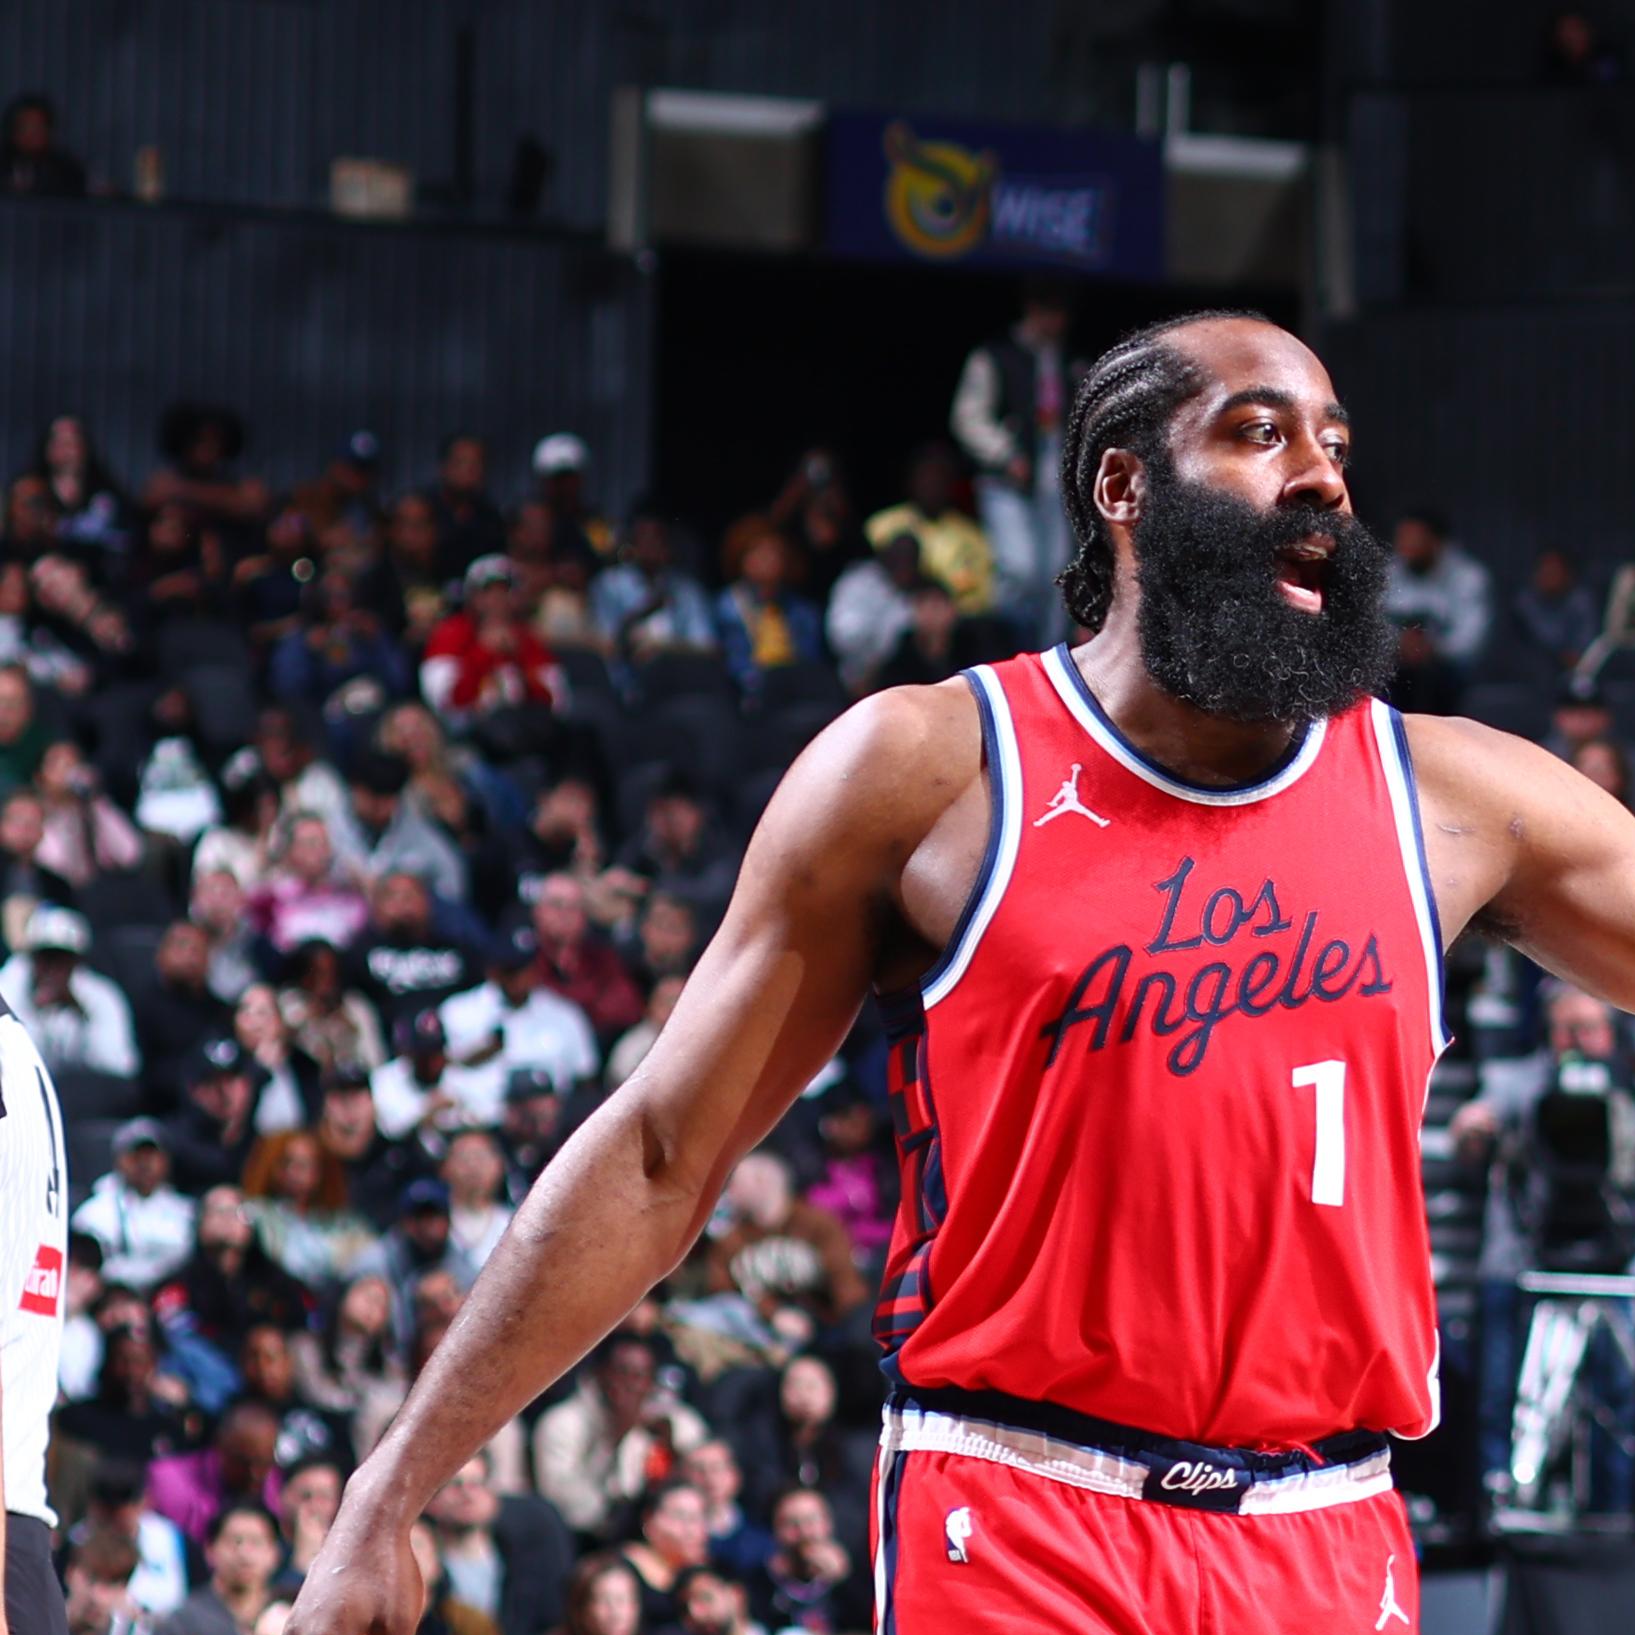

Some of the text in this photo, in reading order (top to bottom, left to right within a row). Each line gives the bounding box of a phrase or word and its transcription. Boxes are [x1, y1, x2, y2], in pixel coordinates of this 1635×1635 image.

[1146, 856, 1292, 954] Los
[1041, 911, 1395, 1077] Angeles
[1292, 1060, 1346, 1207] 1
[1161, 1461, 1238, 1497] Clips
